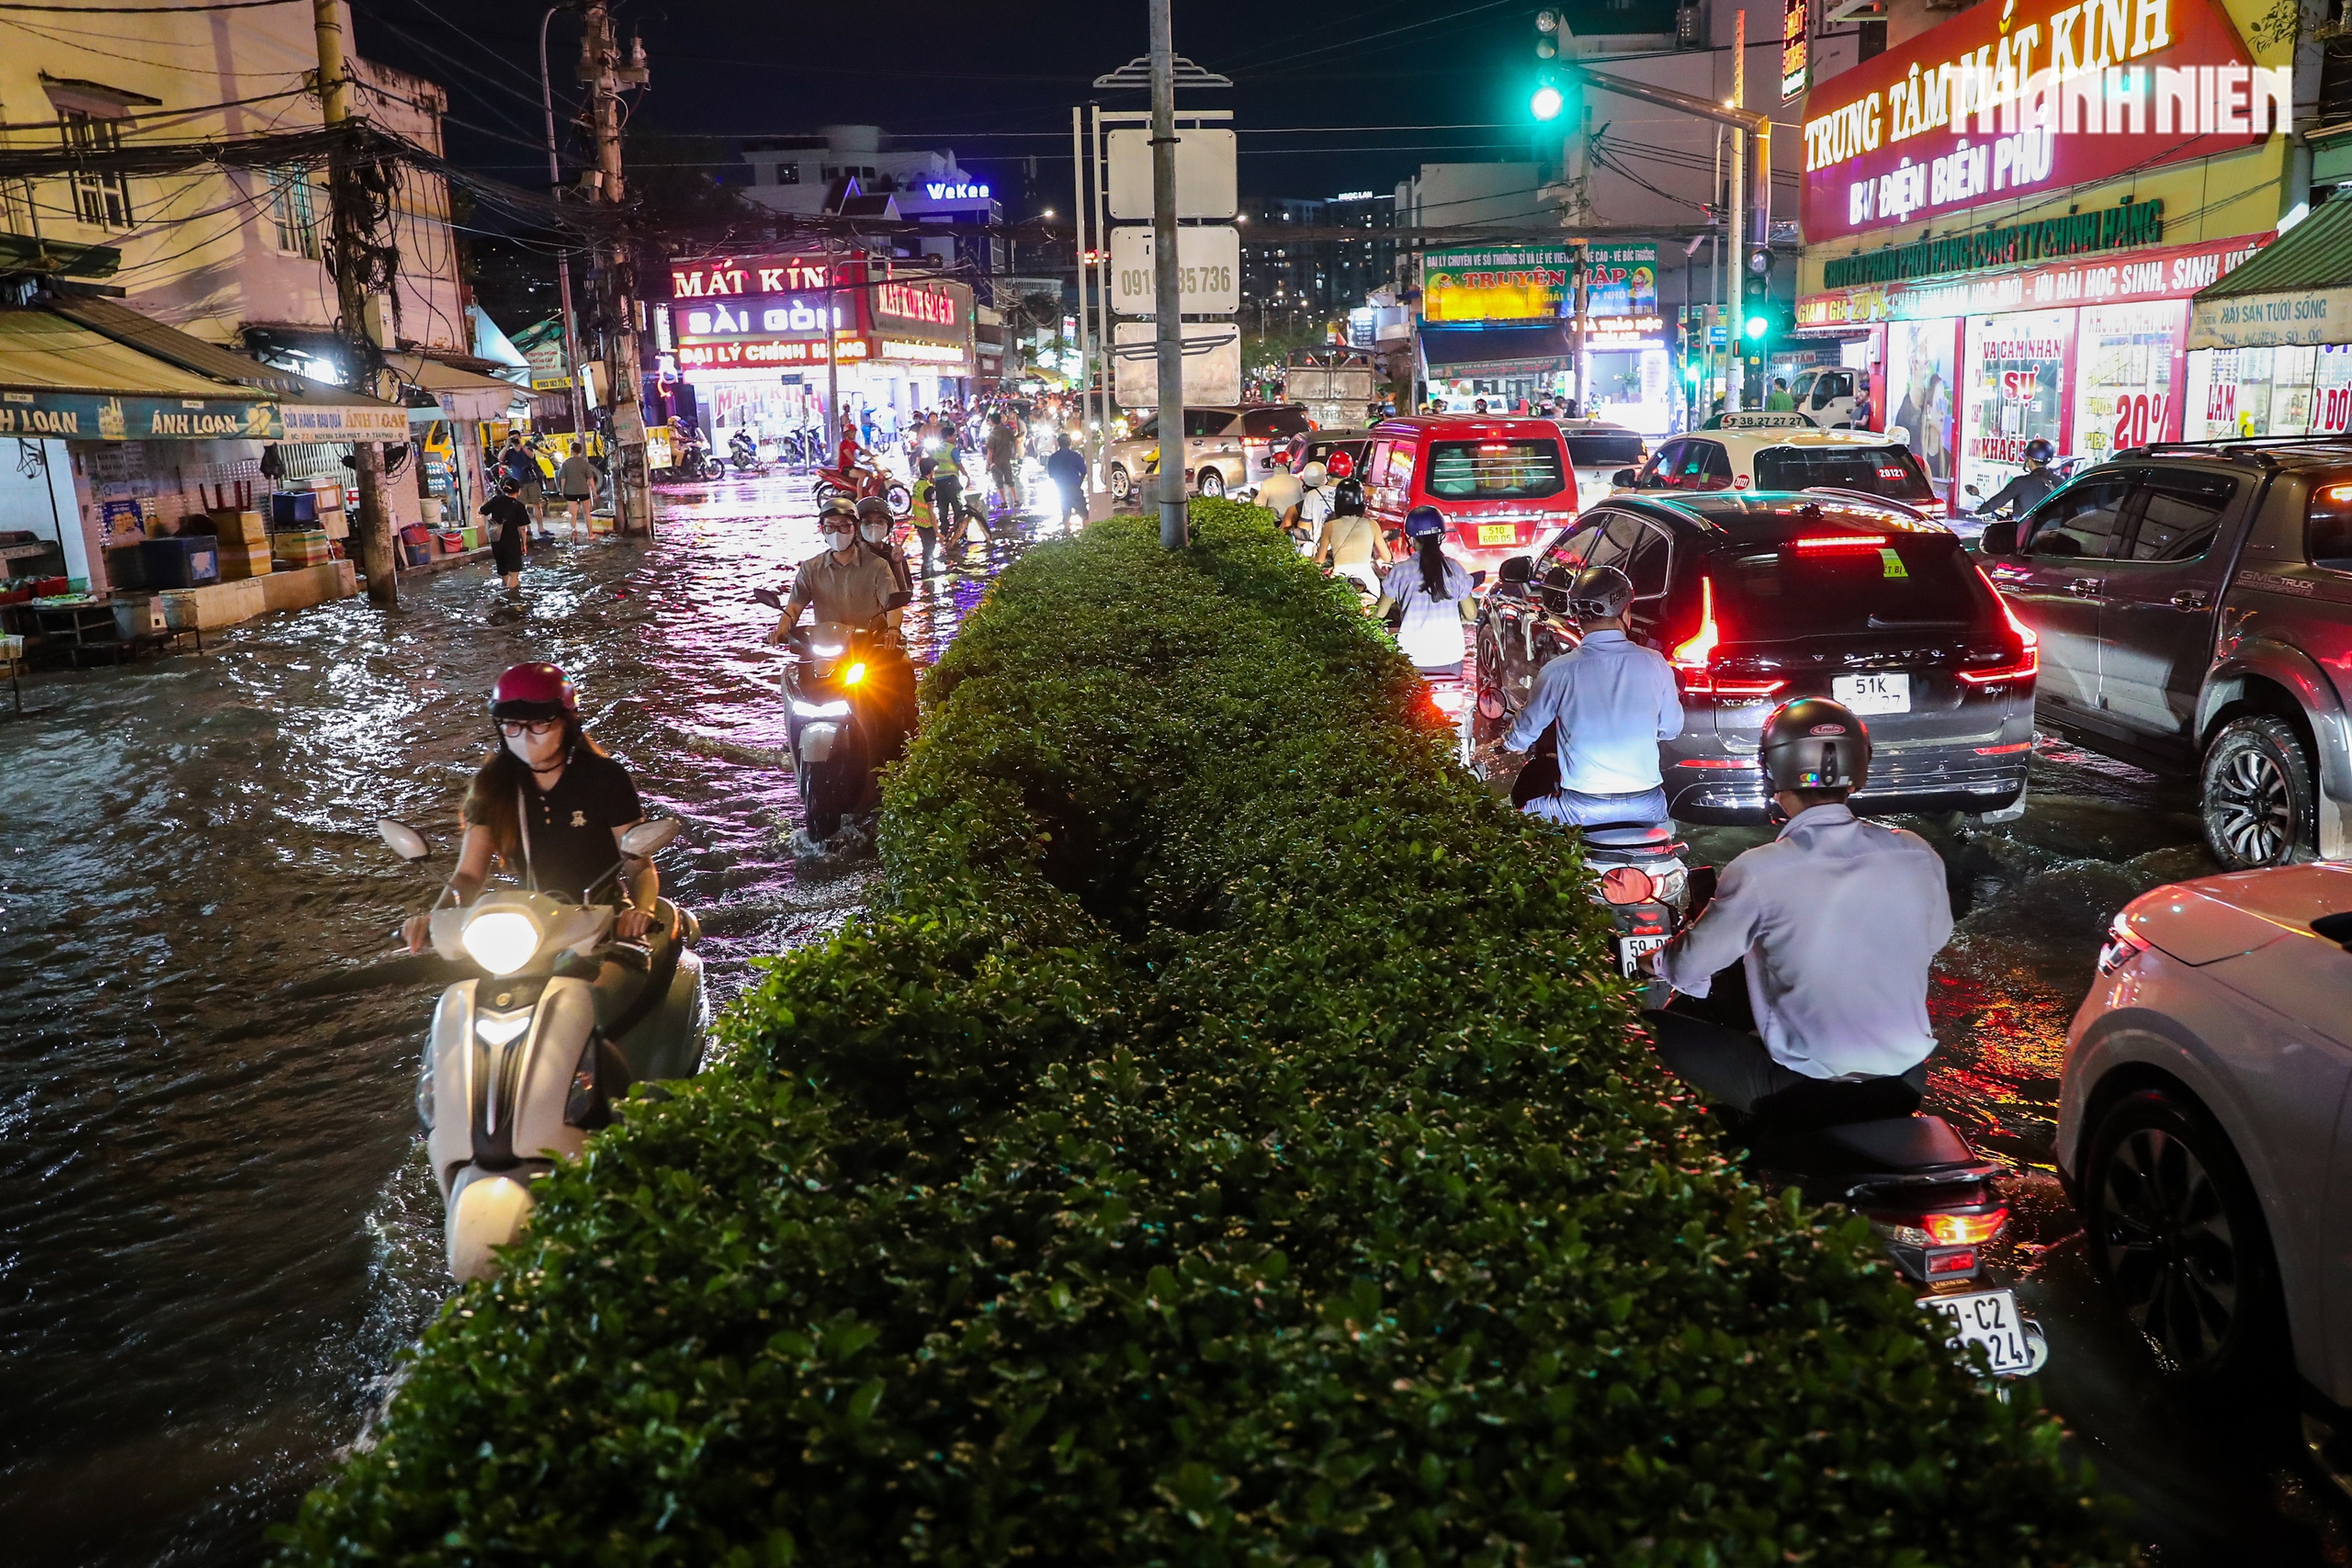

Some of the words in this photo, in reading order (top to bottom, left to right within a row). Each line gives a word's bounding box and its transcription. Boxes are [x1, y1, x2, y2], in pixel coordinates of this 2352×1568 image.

[1804, 92, 1883, 174] TRUNG
[1889, 62, 1951, 143] TÂM
[1931, 139, 1988, 206] BIÊN
[1994, 104, 2054, 191] PHỦ
[926, 183, 989, 200] WeKee
[2018, 221, 2041, 262] TY
[1427, 255, 1438, 269] ĐẠI
[672, 258, 752, 299] MẮT
[1200, 265, 1231, 293] 736
[1462, 265, 1566, 291] TRUYỆN
[1851, 290, 1888, 320] 20%
[2085, 266, 2117, 303] HỌC
[2172, 254, 2220, 290] SINH
[688, 303, 750, 334] SÀI
[763, 299, 842, 332] GÒN
[679, 346, 714, 366] ĐẠI
[718, 342, 741, 362] LÝ
[745, 340, 807, 361] CHÍNH
[2004, 365, 2039, 408] SỰ
[20, 410, 79, 434] LOAN
[152, 410, 188, 434] ÁNH
[192, 413, 240, 434] LOAN
[284, 408, 298, 428] CỬA
[299, 411, 315, 428] HÀNG
[316, 413, 328, 428] RAU
[328, 410, 342, 430] QUẢ
[1772, 416, 1785, 425] 27
[1789, 416, 1803, 425] 27
[1981, 431, 2016, 460] KHÁC
[1879, 468, 1905, 478] 20121
[2239, 570, 2282, 584] GMC
[2280, 577, 2315, 590] TRUCK
[1855, 678, 1888, 695] 51K
[1935, 1278, 1971, 1287] HONDA
